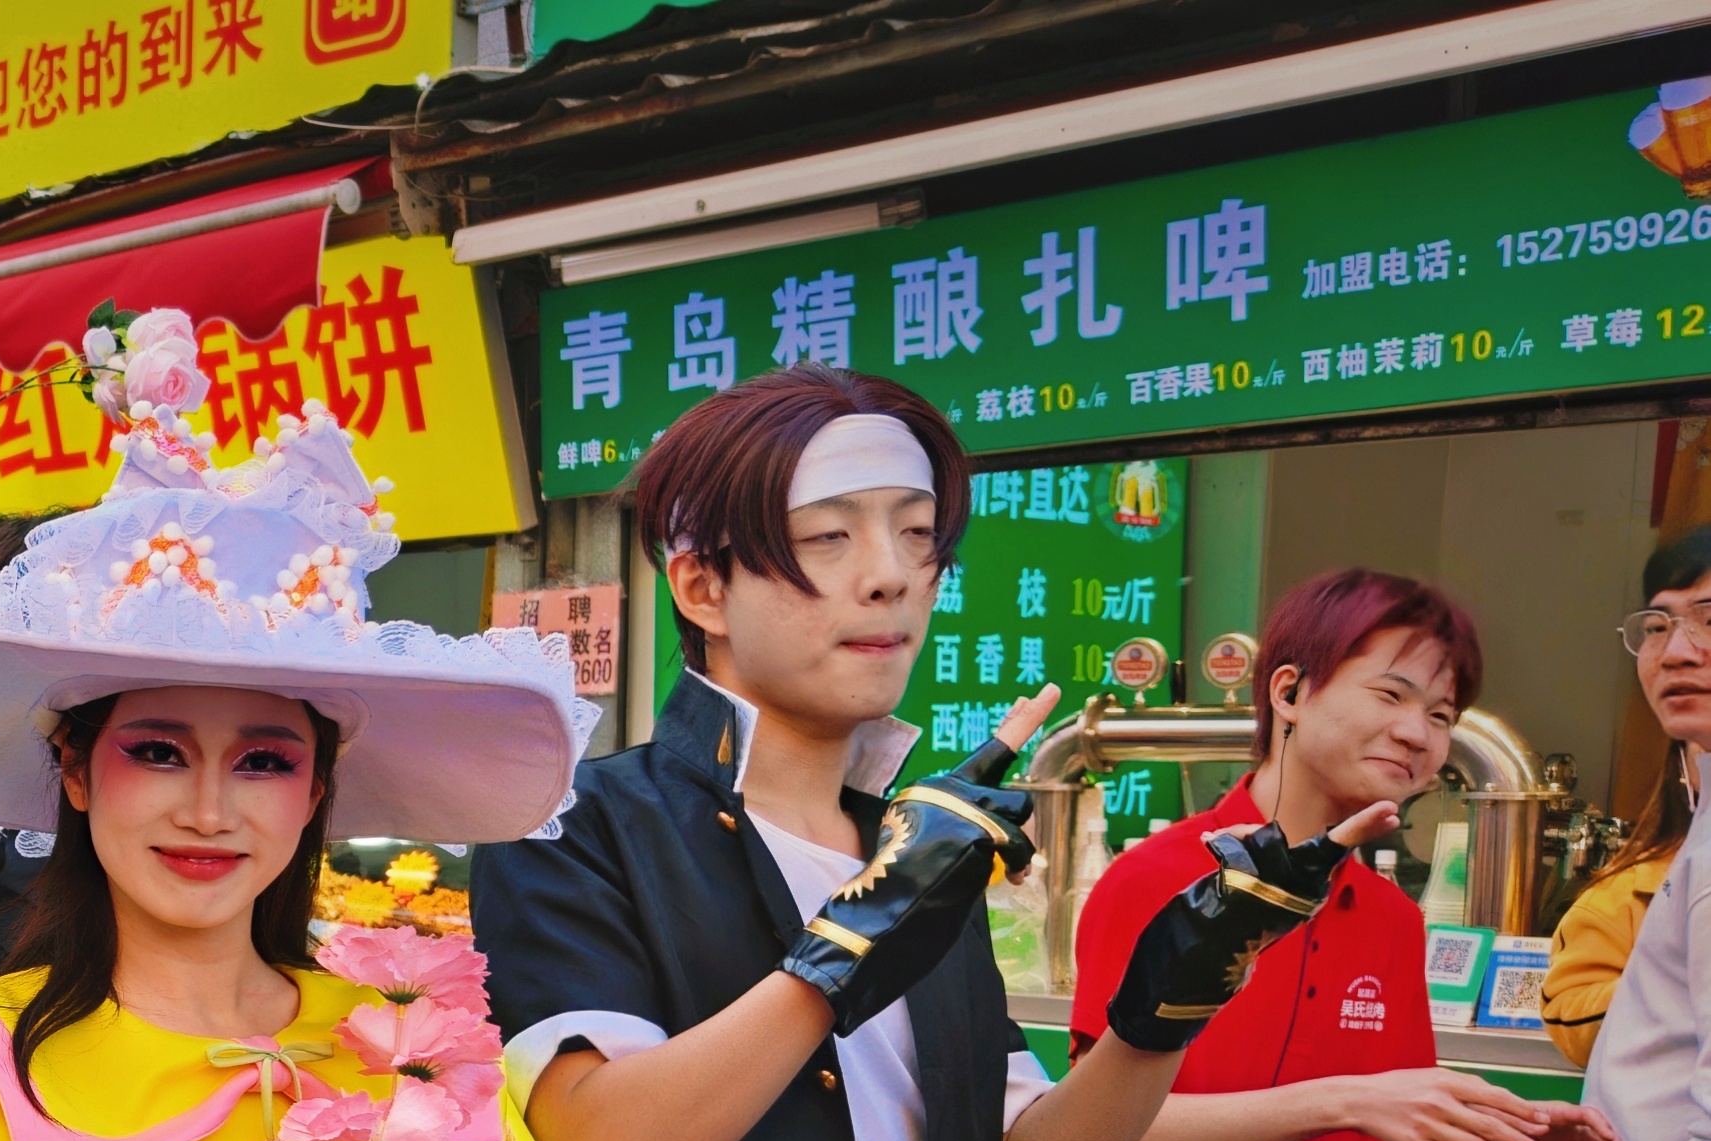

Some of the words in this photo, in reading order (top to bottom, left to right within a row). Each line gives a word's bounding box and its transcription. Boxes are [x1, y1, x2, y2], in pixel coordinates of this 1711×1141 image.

[1301, 239, 1467, 300] 加盟电话：
[559, 198, 1269, 411] 青岛精酿扎啤
[933, 633, 1045, 685] 百香果
